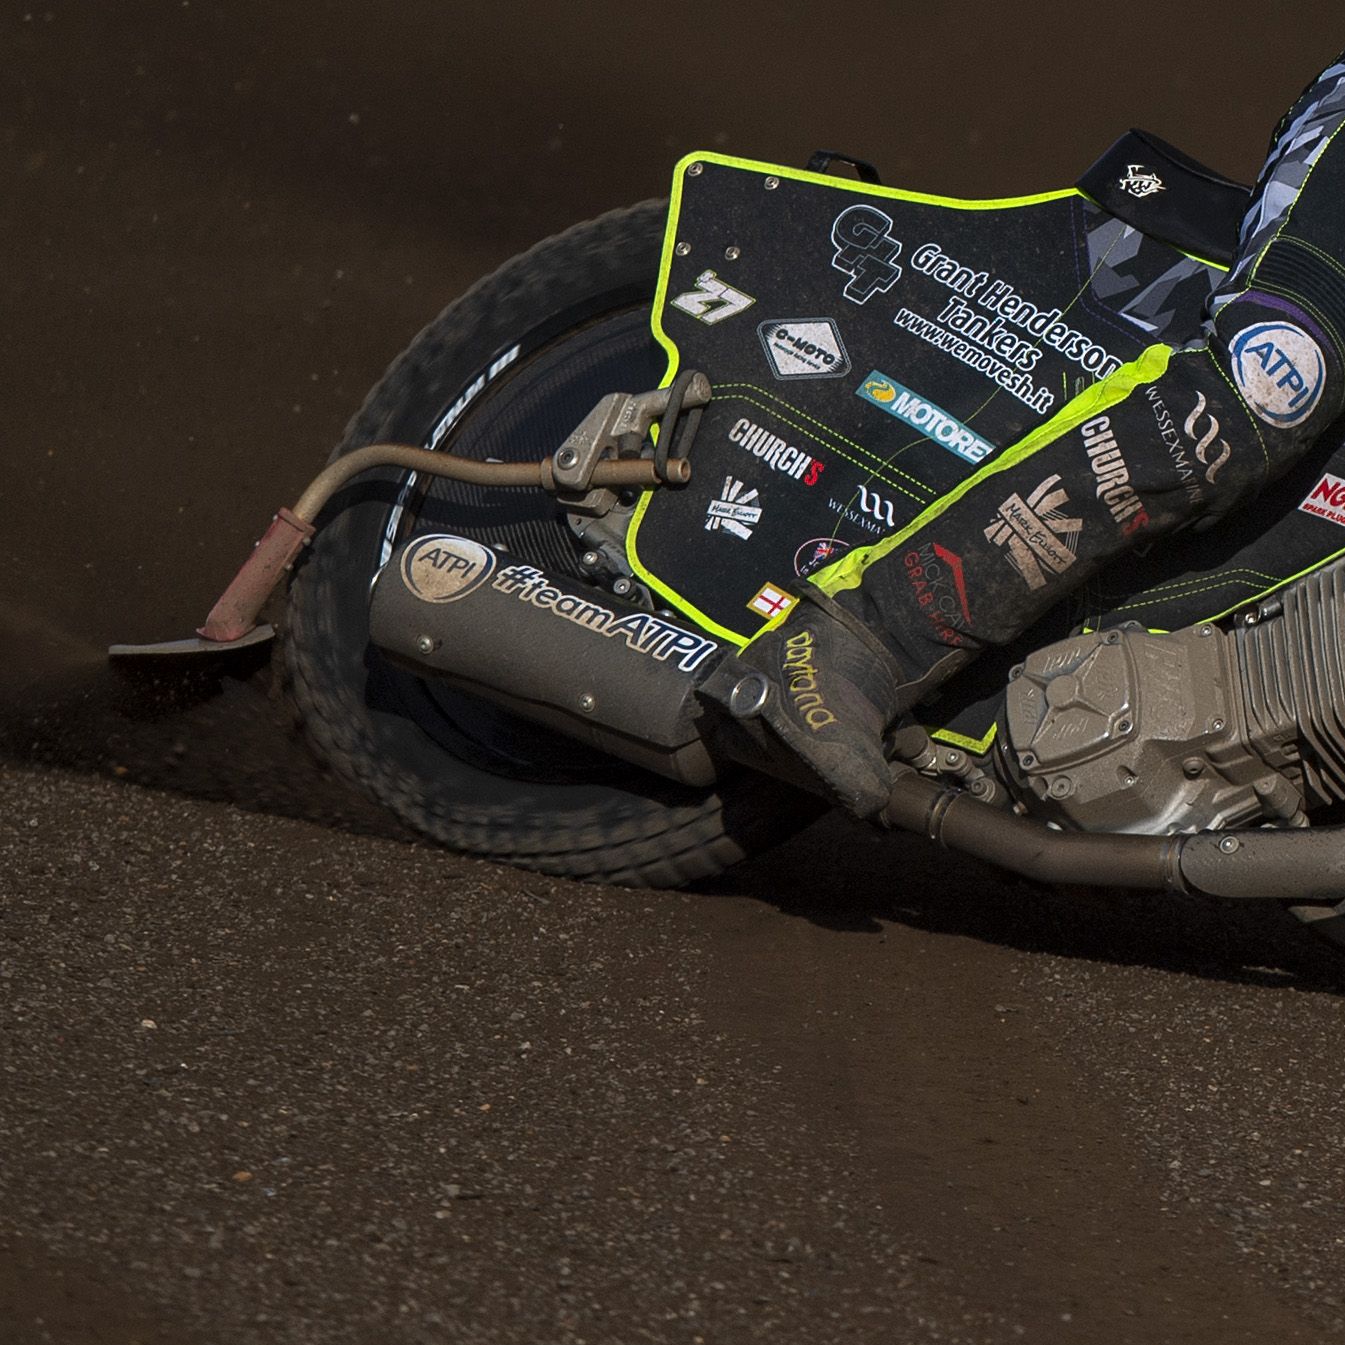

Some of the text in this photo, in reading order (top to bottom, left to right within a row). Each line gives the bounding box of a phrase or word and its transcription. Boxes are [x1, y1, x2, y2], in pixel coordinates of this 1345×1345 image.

[911, 243, 1124, 380] Grant Henderson
[936, 296, 1043, 372] Tankers
[894, 308, 1056, 415] www.wemovesh.it
[1245, 341, 1311, 408] ATPI
[417, 547, 478, 579] ATPI
[903, 551, 935, 609] GRAB
[493, 564, 720, 673] #teamATPI
